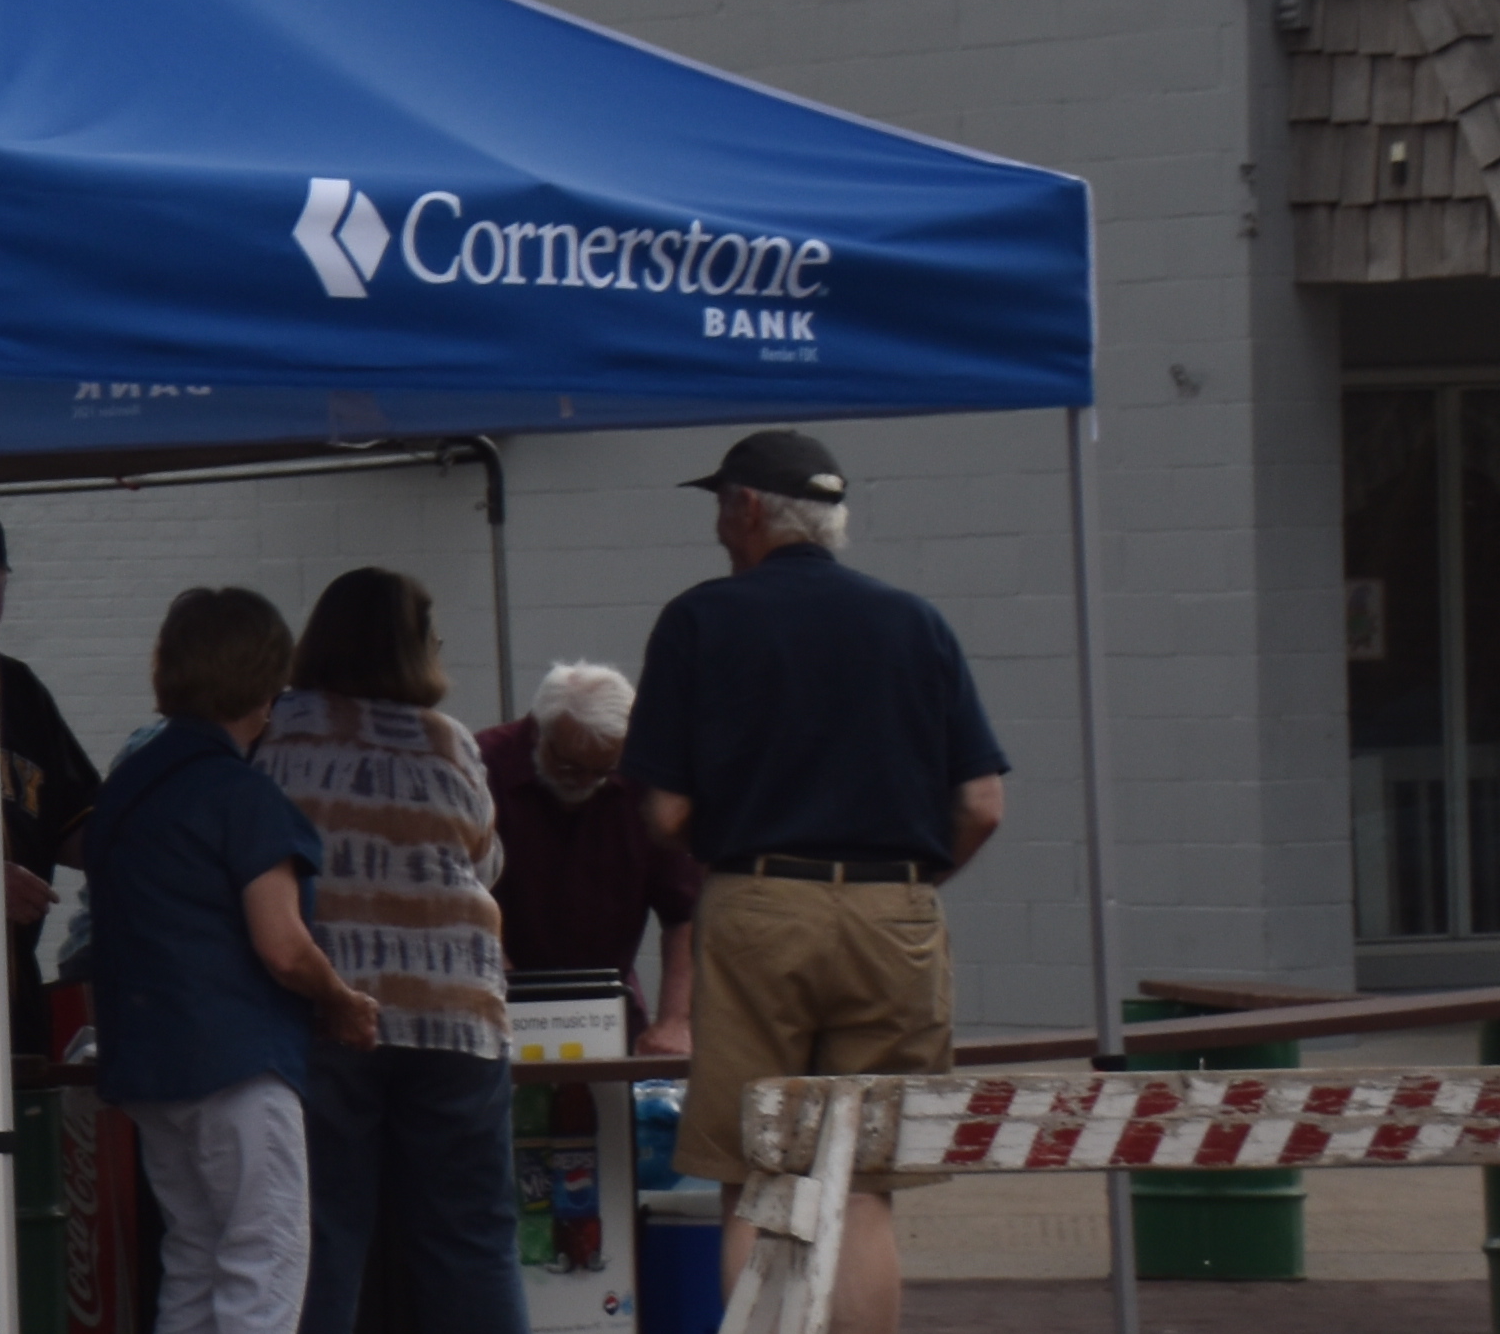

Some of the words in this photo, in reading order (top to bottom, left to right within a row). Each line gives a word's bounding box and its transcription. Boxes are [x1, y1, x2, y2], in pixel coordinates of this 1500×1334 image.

[402, 190, 831, 298] Cornerstone
[704, 307, 815, 340] BANK
[512, 1018, 548, 1031] some
[551, 1011, 587, 1029] music
